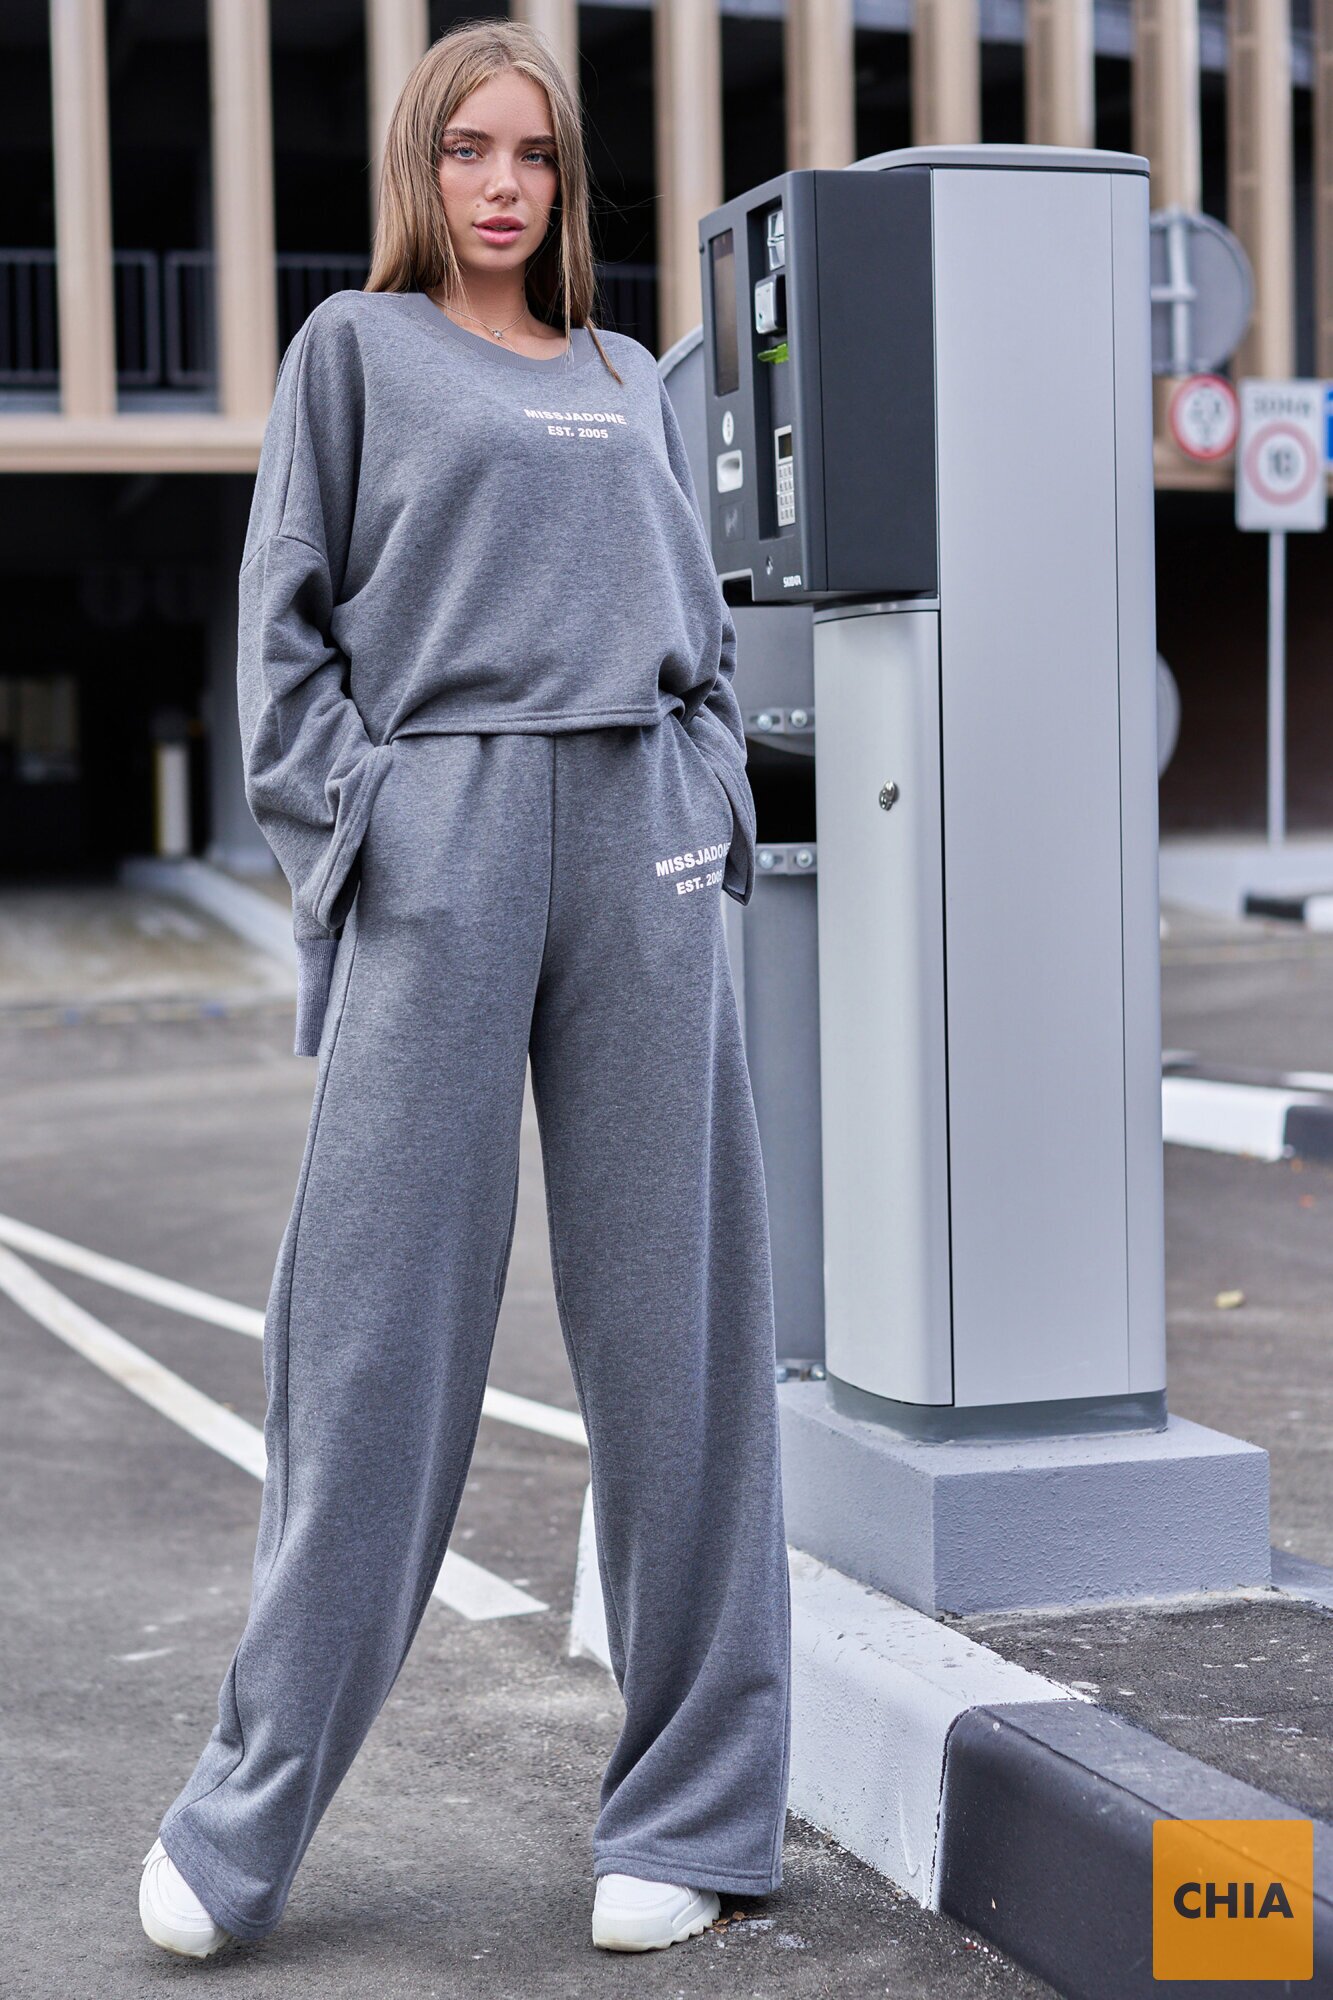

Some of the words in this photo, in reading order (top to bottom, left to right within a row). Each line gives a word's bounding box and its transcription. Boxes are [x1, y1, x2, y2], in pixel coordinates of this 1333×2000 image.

[524, 409, 627, 425] MISSJADONE
[547, 425, 575, 437] EST.
[577, 428, 609, 439] 2005
[675, 877, 704, 895] EST.
